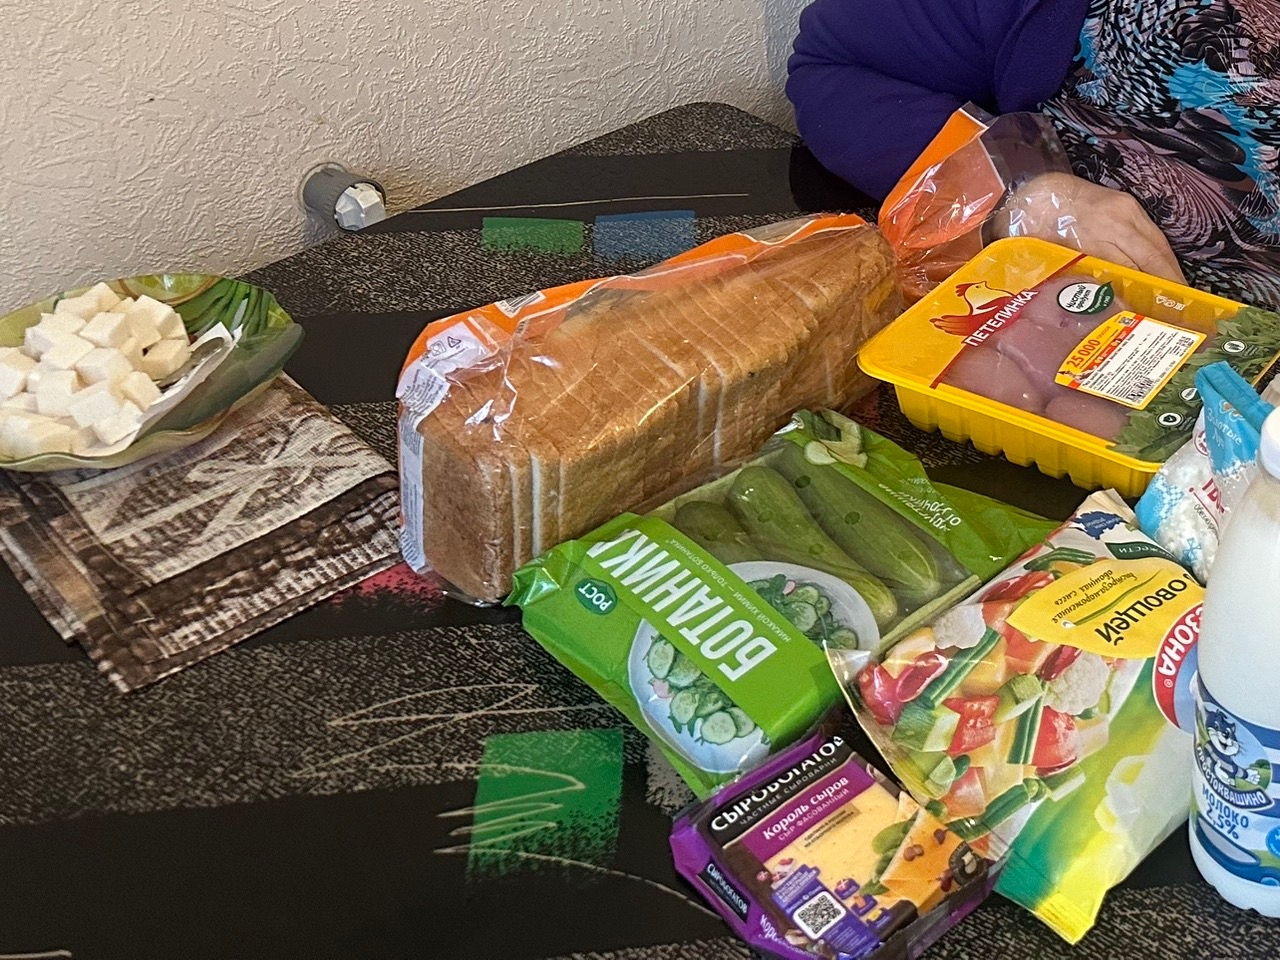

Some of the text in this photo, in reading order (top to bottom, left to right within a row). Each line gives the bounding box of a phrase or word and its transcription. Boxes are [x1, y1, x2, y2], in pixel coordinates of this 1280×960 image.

[963, 290, 1039, 347] ПЕТЕЛИНКА
[1066, 354, 1081, 368] 25
[578, 582, 613, 611] РОСТ
[1079, 569, 1113, 593] овощная
[739, 757, 837, 825] ЧАСТНЫЕ СЫРОВАРНИ
[762, 777, 849, 840] Король сыров
[795, 787, 850, 827] ФАСОВАННЫЙ
[1202, 782, 1250, 828] МОЛОКО
[1206, 803, 1239, 840] 2,5%
